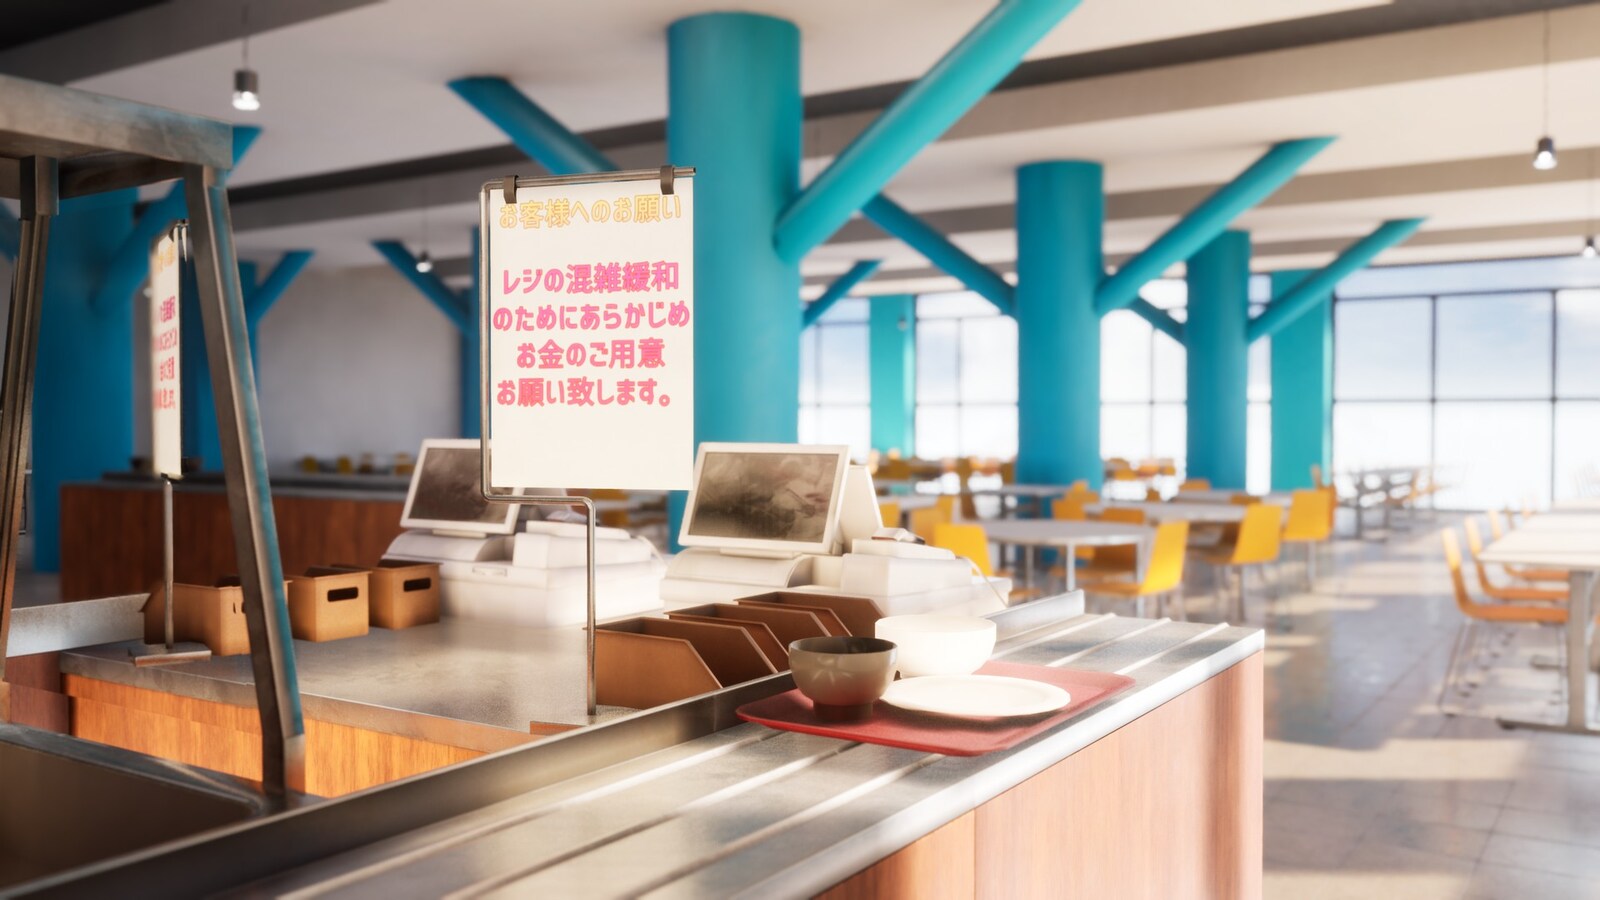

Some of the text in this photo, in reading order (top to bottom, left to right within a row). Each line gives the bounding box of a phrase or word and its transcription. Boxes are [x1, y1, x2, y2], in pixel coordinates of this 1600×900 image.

[500, 194, 681, 229] お客様へのお願い
[503, 260, 679, 295] レジの混雑緩和
[493, 300, 690, 331] のためにあらかじめ
[516, 337, 666, 369] お金のご用意
[497, 376, 670, 407] お願い致します。
